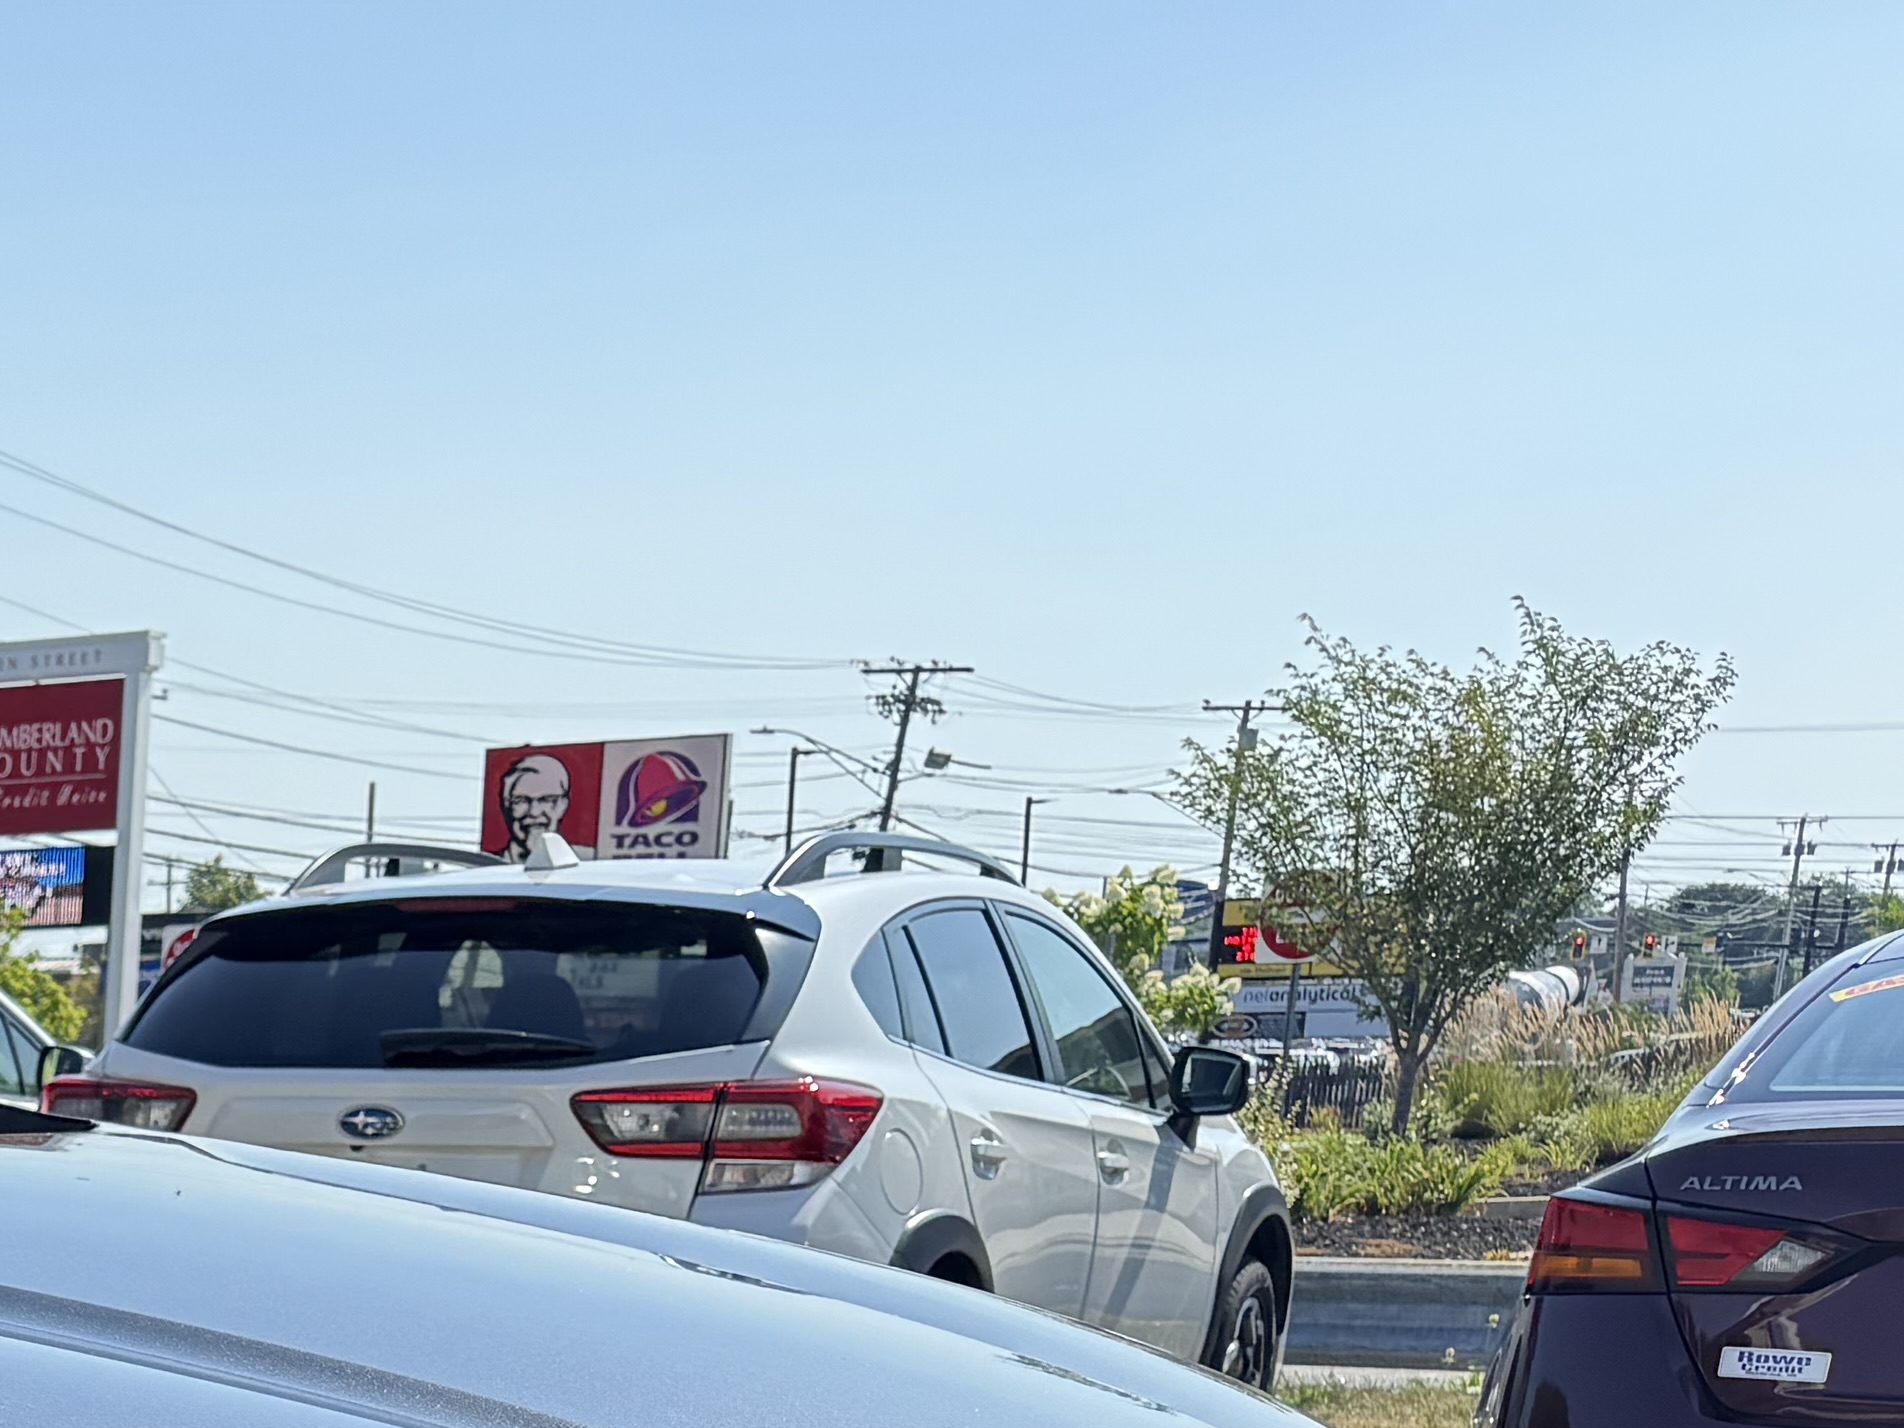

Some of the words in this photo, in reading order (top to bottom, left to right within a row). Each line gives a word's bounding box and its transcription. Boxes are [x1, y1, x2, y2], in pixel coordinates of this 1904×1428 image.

[31, 649, 103, 669] STREET
[56, 783, 107, 807] Union
[610, 830, 699, 850] TACO
[1680, 1175, 1804, 1191] ALTIMA
